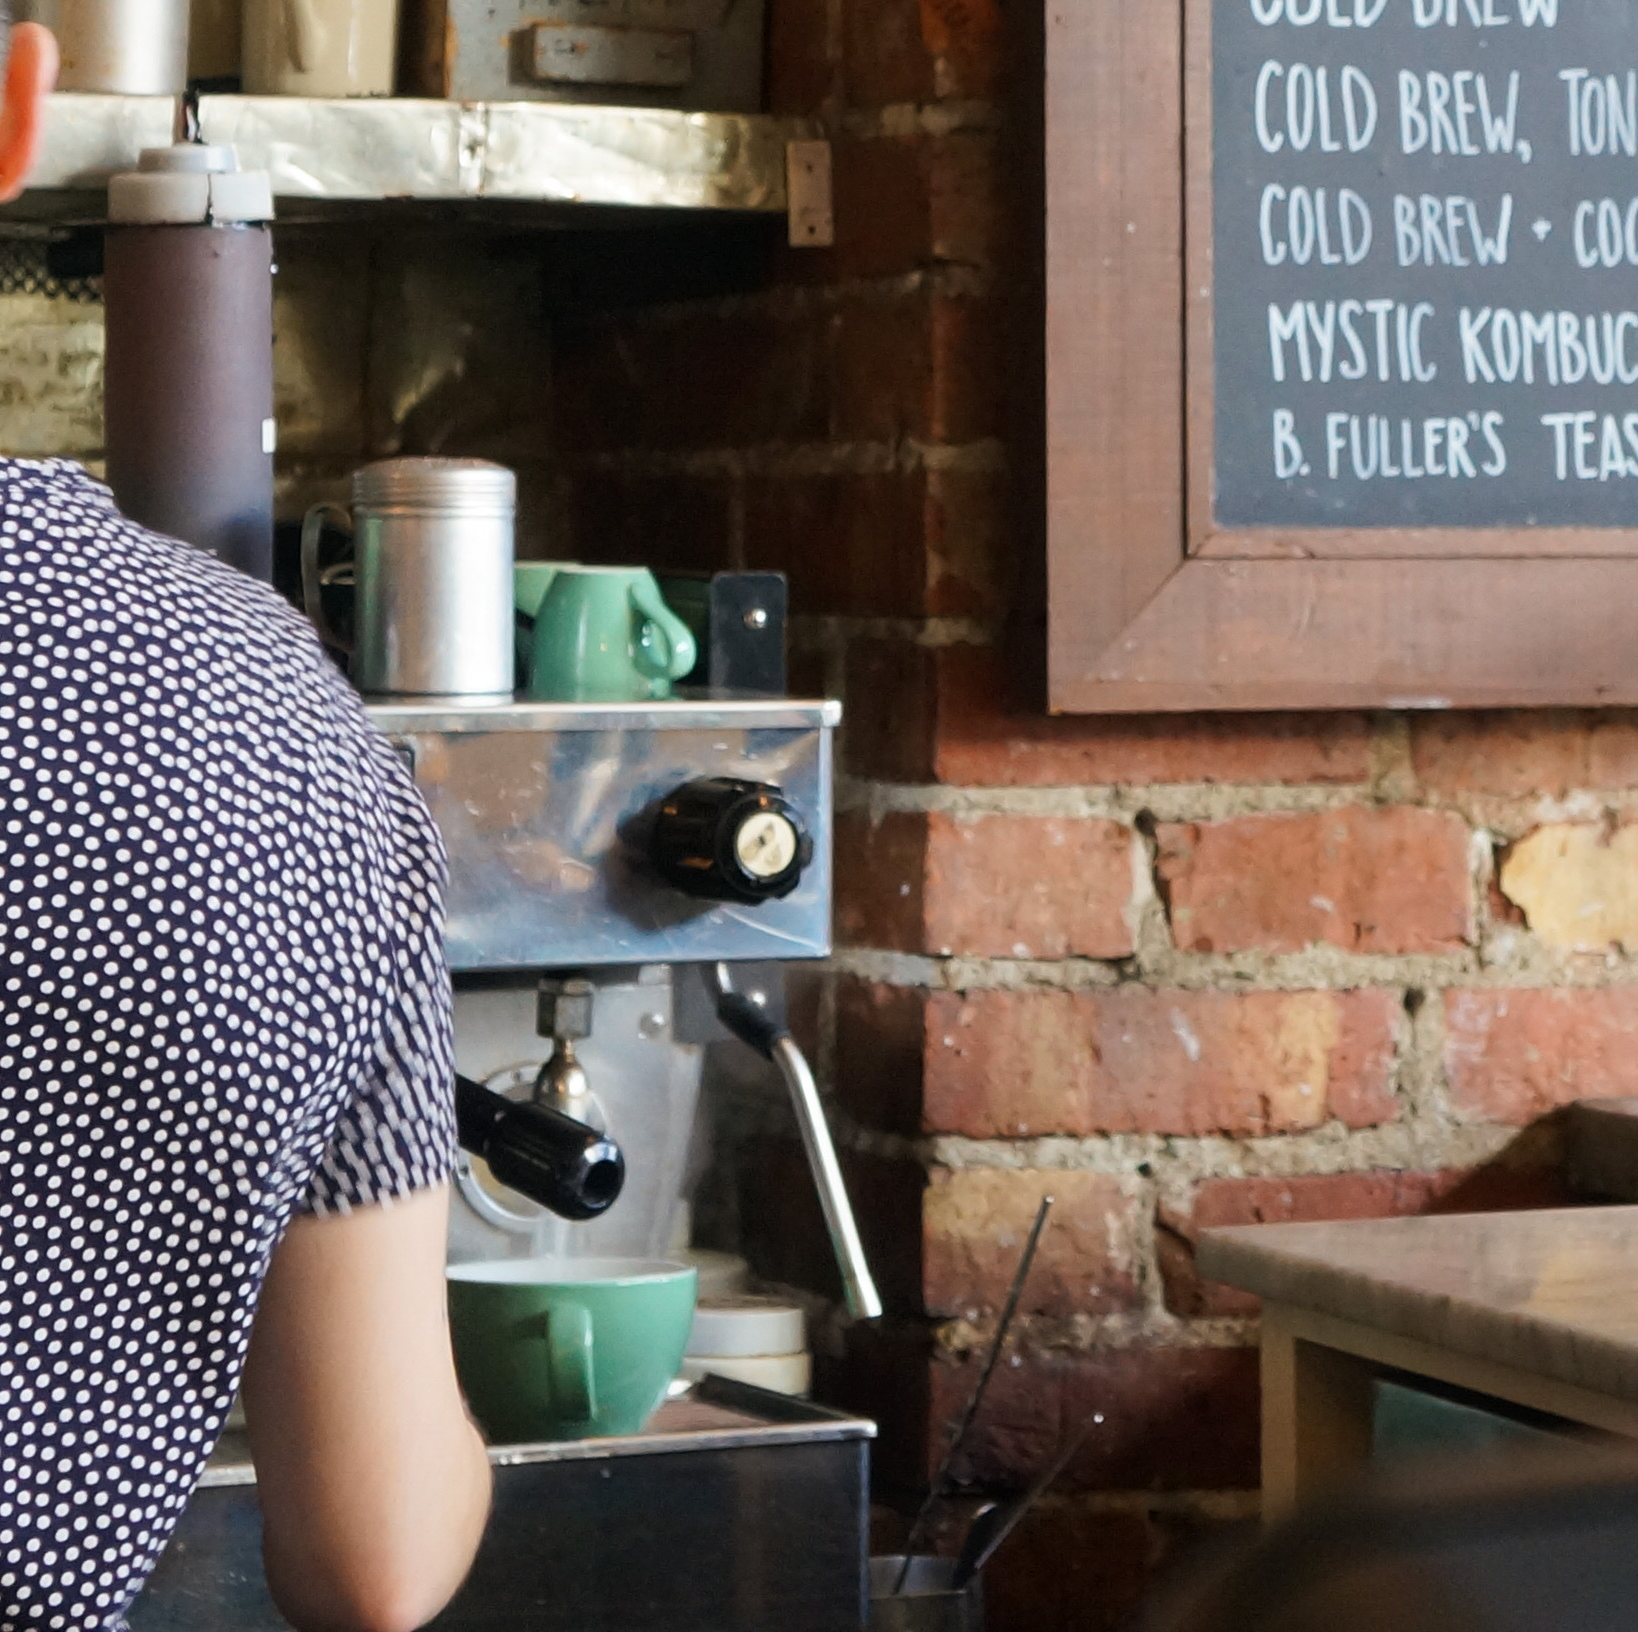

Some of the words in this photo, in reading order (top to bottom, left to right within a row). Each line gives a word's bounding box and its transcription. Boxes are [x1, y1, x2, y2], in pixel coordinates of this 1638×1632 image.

[1255, 59, 1378, 153] COLD
[1398, 68, 1532, 164] BREW,
[1260, 183, 1373, 266] COLD
[1393, 192, 1513, 267] BREW
[1268, 298, 1437, 383] MYSTIC
[1272, 407, 1311, 480] B.
[1326, 410, 1507, 480] FULLER'S
